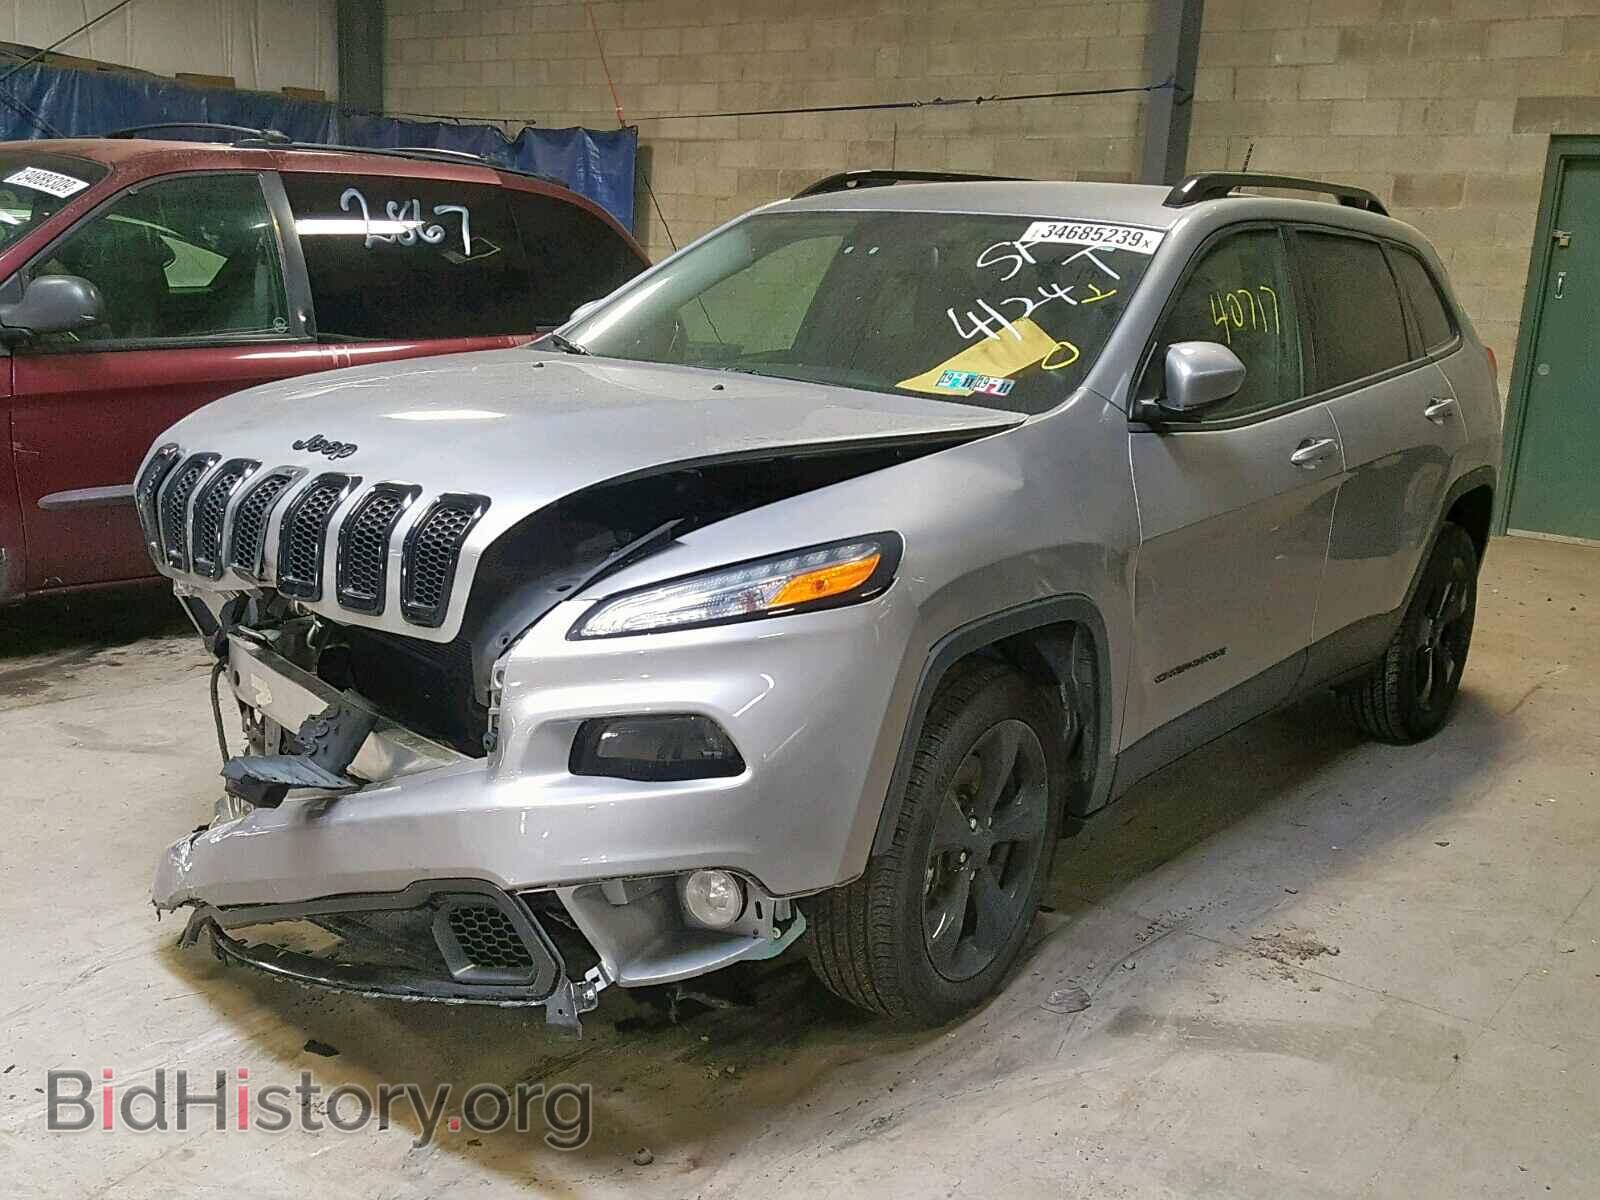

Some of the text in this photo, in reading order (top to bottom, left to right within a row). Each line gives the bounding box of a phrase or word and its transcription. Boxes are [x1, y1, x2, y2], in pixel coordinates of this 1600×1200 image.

[340, 188, 472, 256] 2867
[1041, 224, 1144, 247] 34685239
[1209, 286, 1280, 345] 40717
[293, 433, 358, 461] Jeep
